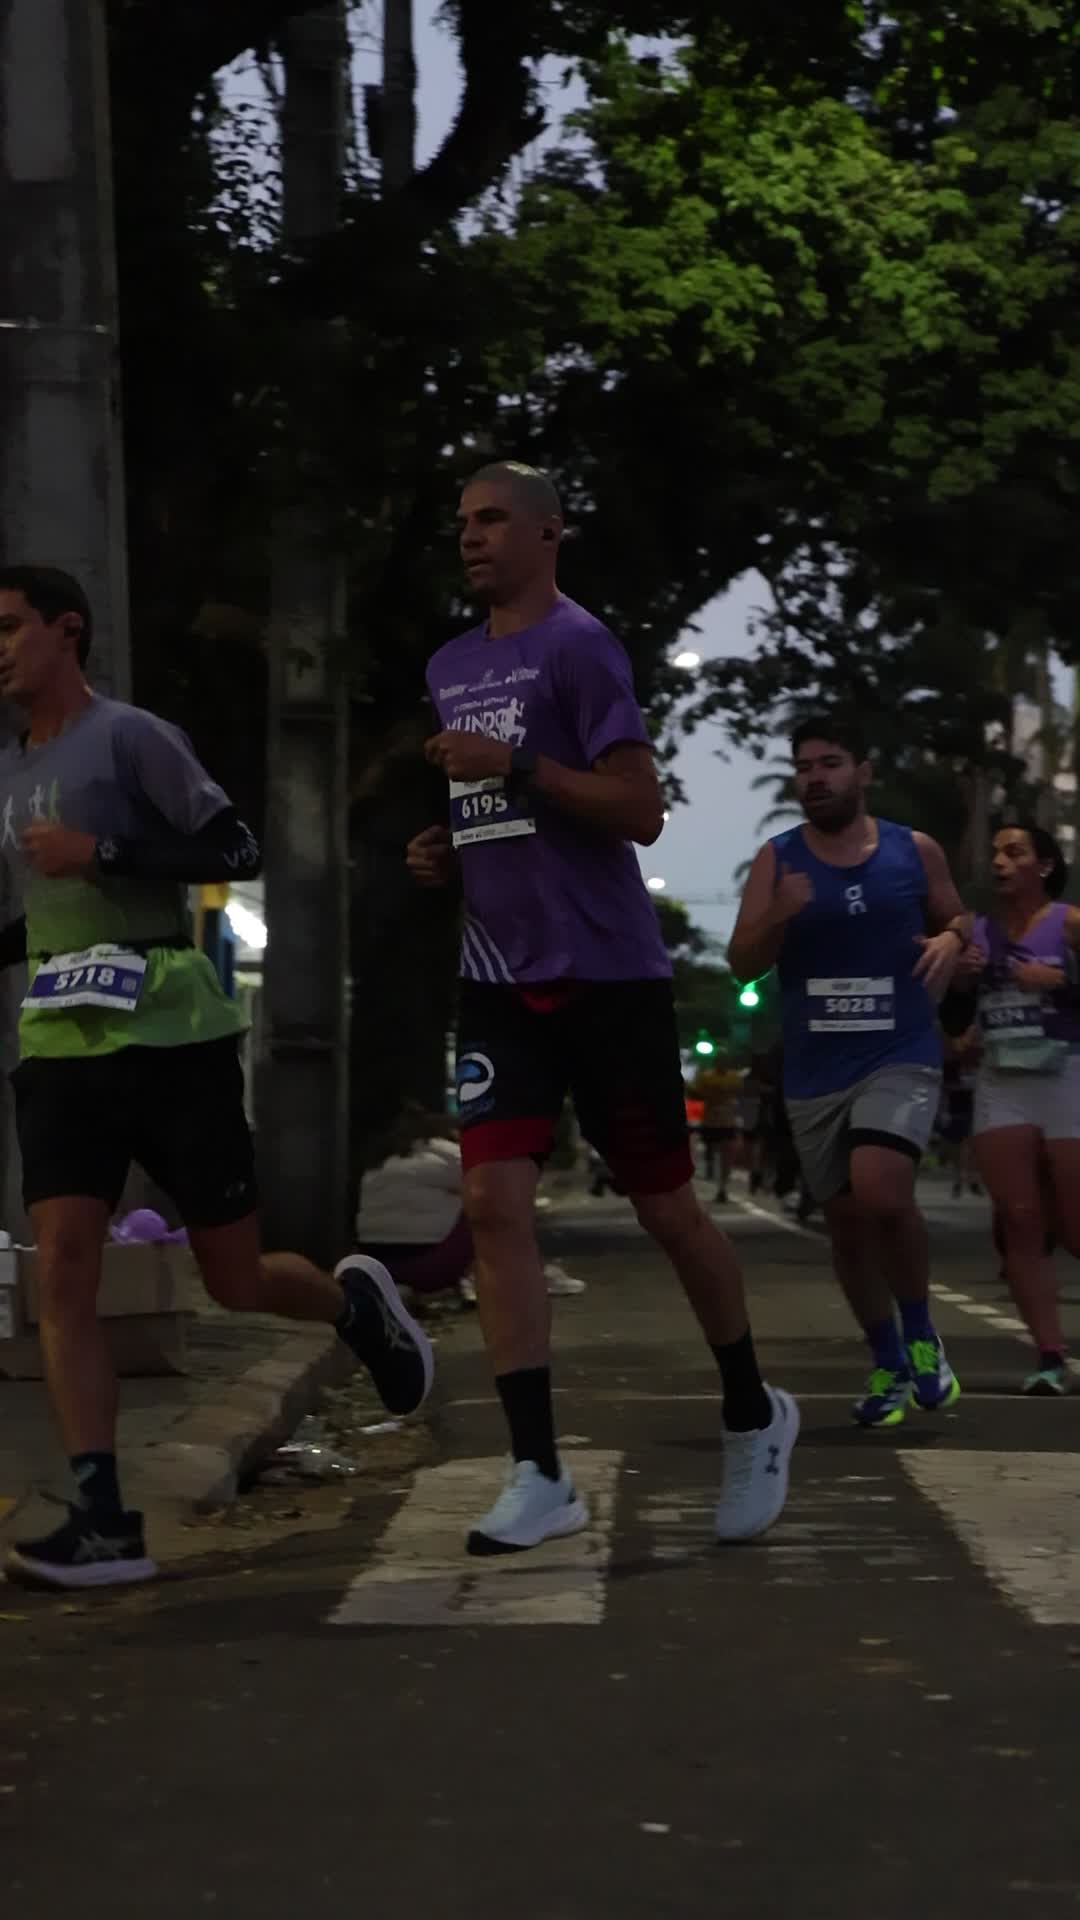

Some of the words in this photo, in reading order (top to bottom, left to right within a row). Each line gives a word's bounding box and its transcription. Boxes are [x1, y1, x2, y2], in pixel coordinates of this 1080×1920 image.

[462, 791, 508, 819] 6195
[54, 966, 116, 991] 5718
[824, 997, 875, 1013] 5028
